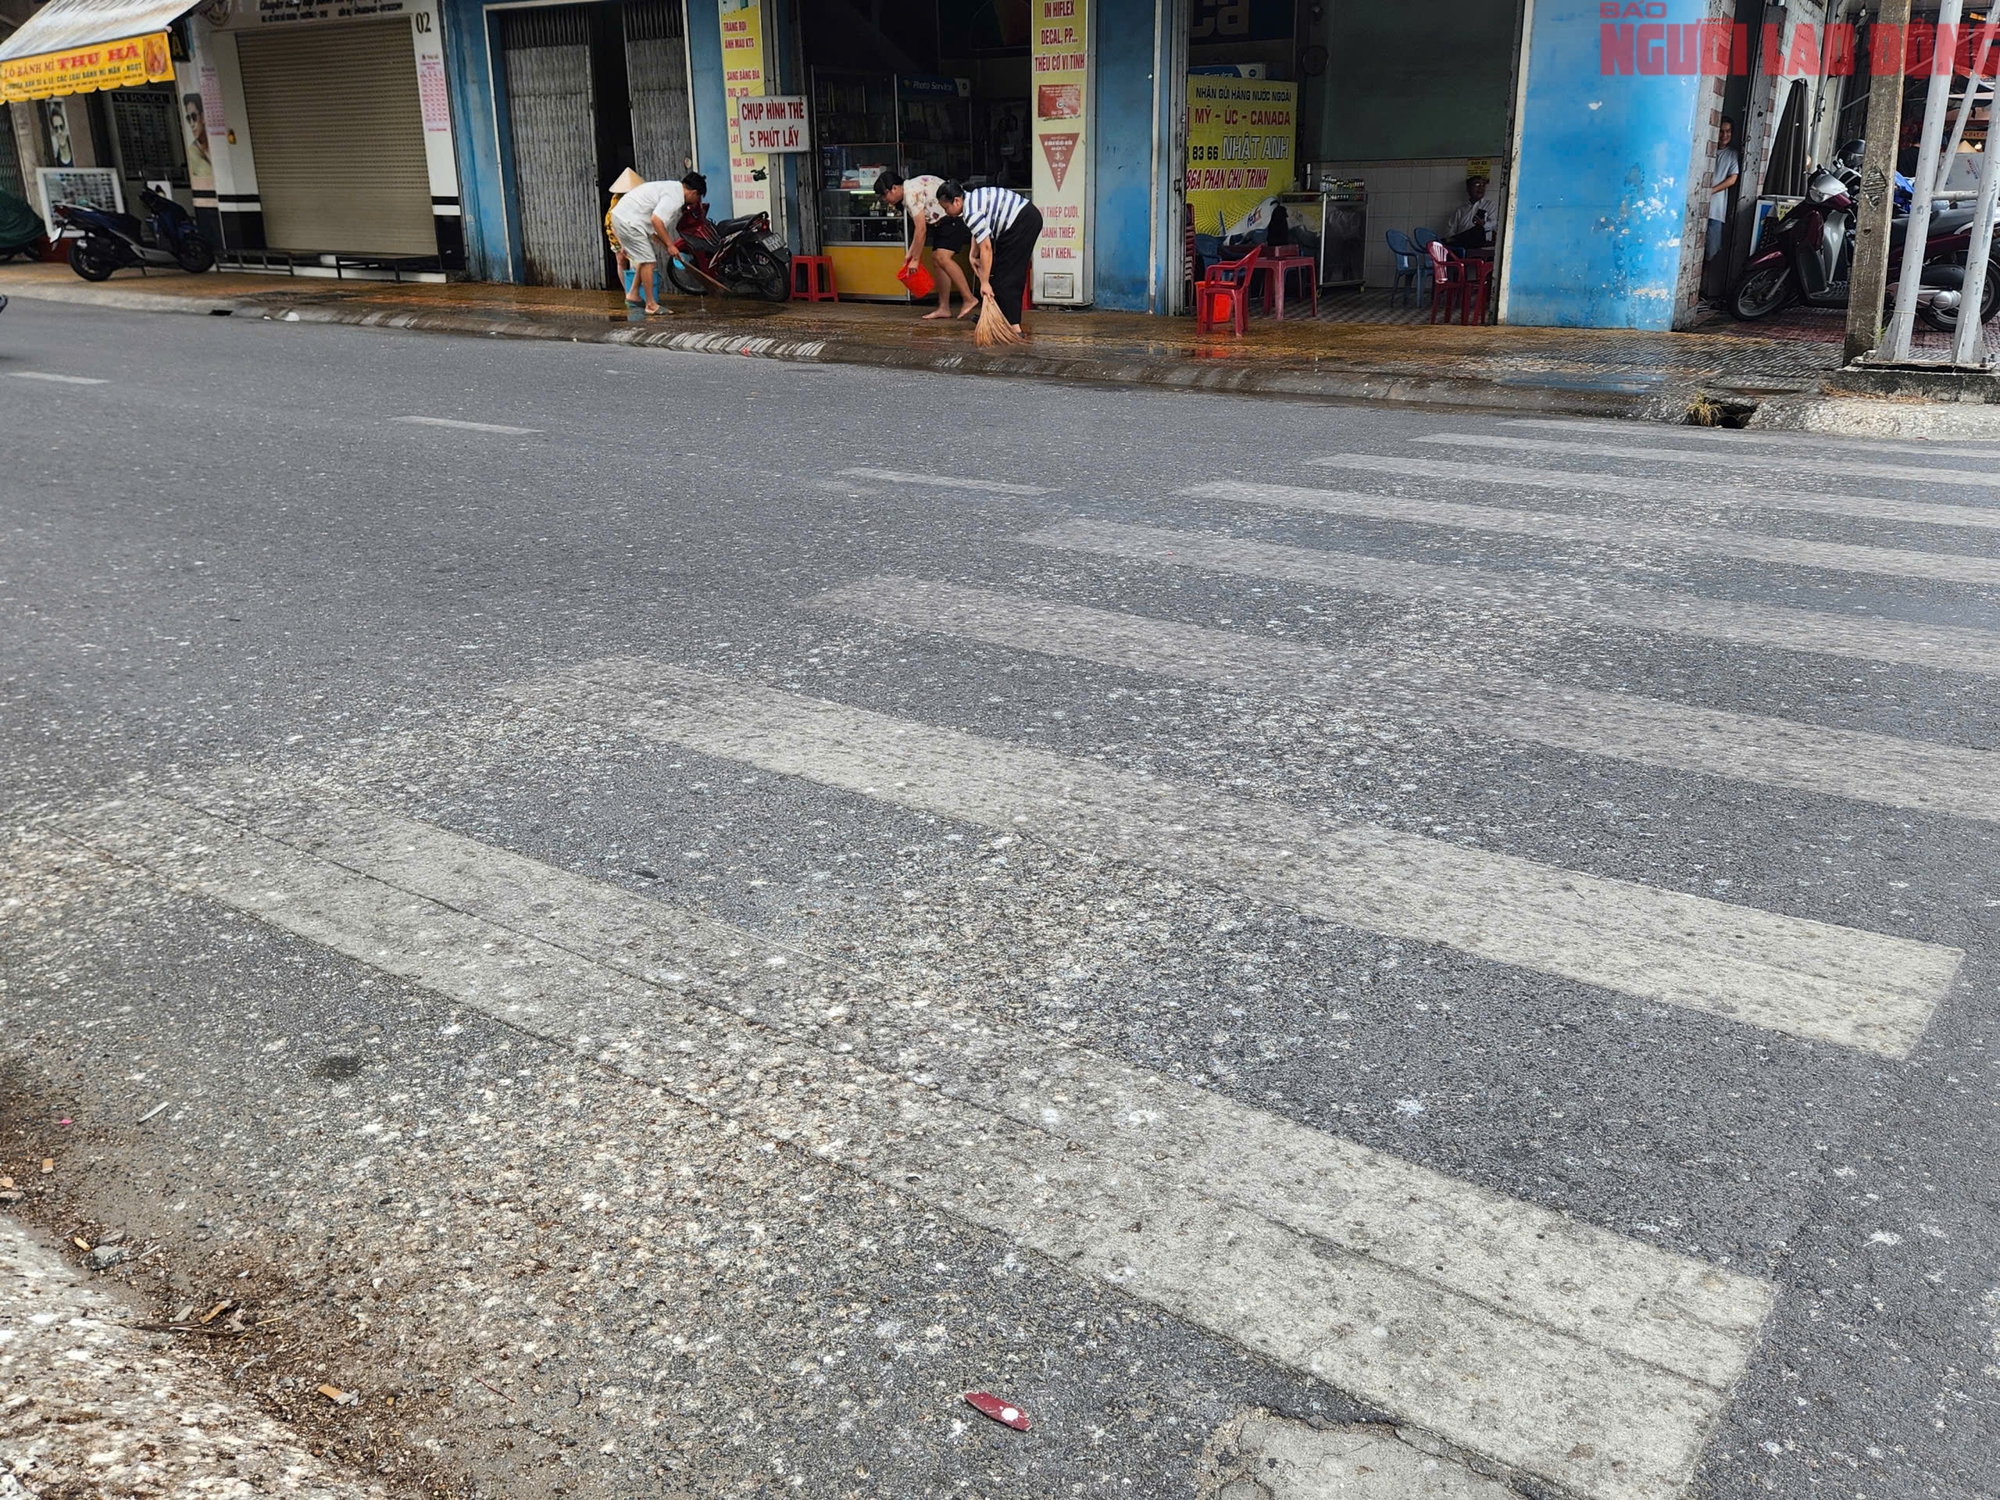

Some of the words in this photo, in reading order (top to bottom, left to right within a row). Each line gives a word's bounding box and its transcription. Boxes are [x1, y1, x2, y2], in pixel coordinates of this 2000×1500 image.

[1044, 2, 1052, 18] IN
[1052, 0, 1074, 18] HIFLEX
[415, 12, 432, 34] 02
[746, 38, 754, 48] KTS
[1041, 28, 1063, 45] DECAL,
[57, 52, 100, 71] THU
[1035, 53, 1050, 72] THÊU
[1062, 54, 1068, 70] VI
[1070, 51, 1085, 70] TÍNH
[726, 71, 738, 80] SANG
[913, 81, 930, 89] Photo
[931, 82, 952, 90] Service
[1196, 86, 1216, 101] NHẬN
[1231, 87, 1250, 100] HÀNG
[1252, 88, 1271, 101] NƯỚC
[1272, 89, 1291, 102] NGOÀI
[742, 102, 764, 124] CHỤP
[766, 98, 786, 120] HÌNH
[788, 96, 804, 119] THẺ
[1195, 105, 1212, 124] MỸ
[1224, 105, 1238, 125] ÚC
[1250, 110, 1291, 126] CANADA
[749, 130, 755, 148] 5
[758, 126, 780, 148] PHÚT
[783, 124, 799, 147] LẤY
[1192, 146, 1204, 160] 83
[1207, 146, 1218, 160] 66
[1222, 132, 1260, 165] NHẬT
[1261, 136, 1290, 160] ANH
[732, 158, 742, 167] MUA
[1203, 168, 1226, 190] PHAN
[1228, 168, 1244, 188] CHU
[1246, 168, 1270, 188] TRINH
[1042, 226, 1057, 238] DANH
